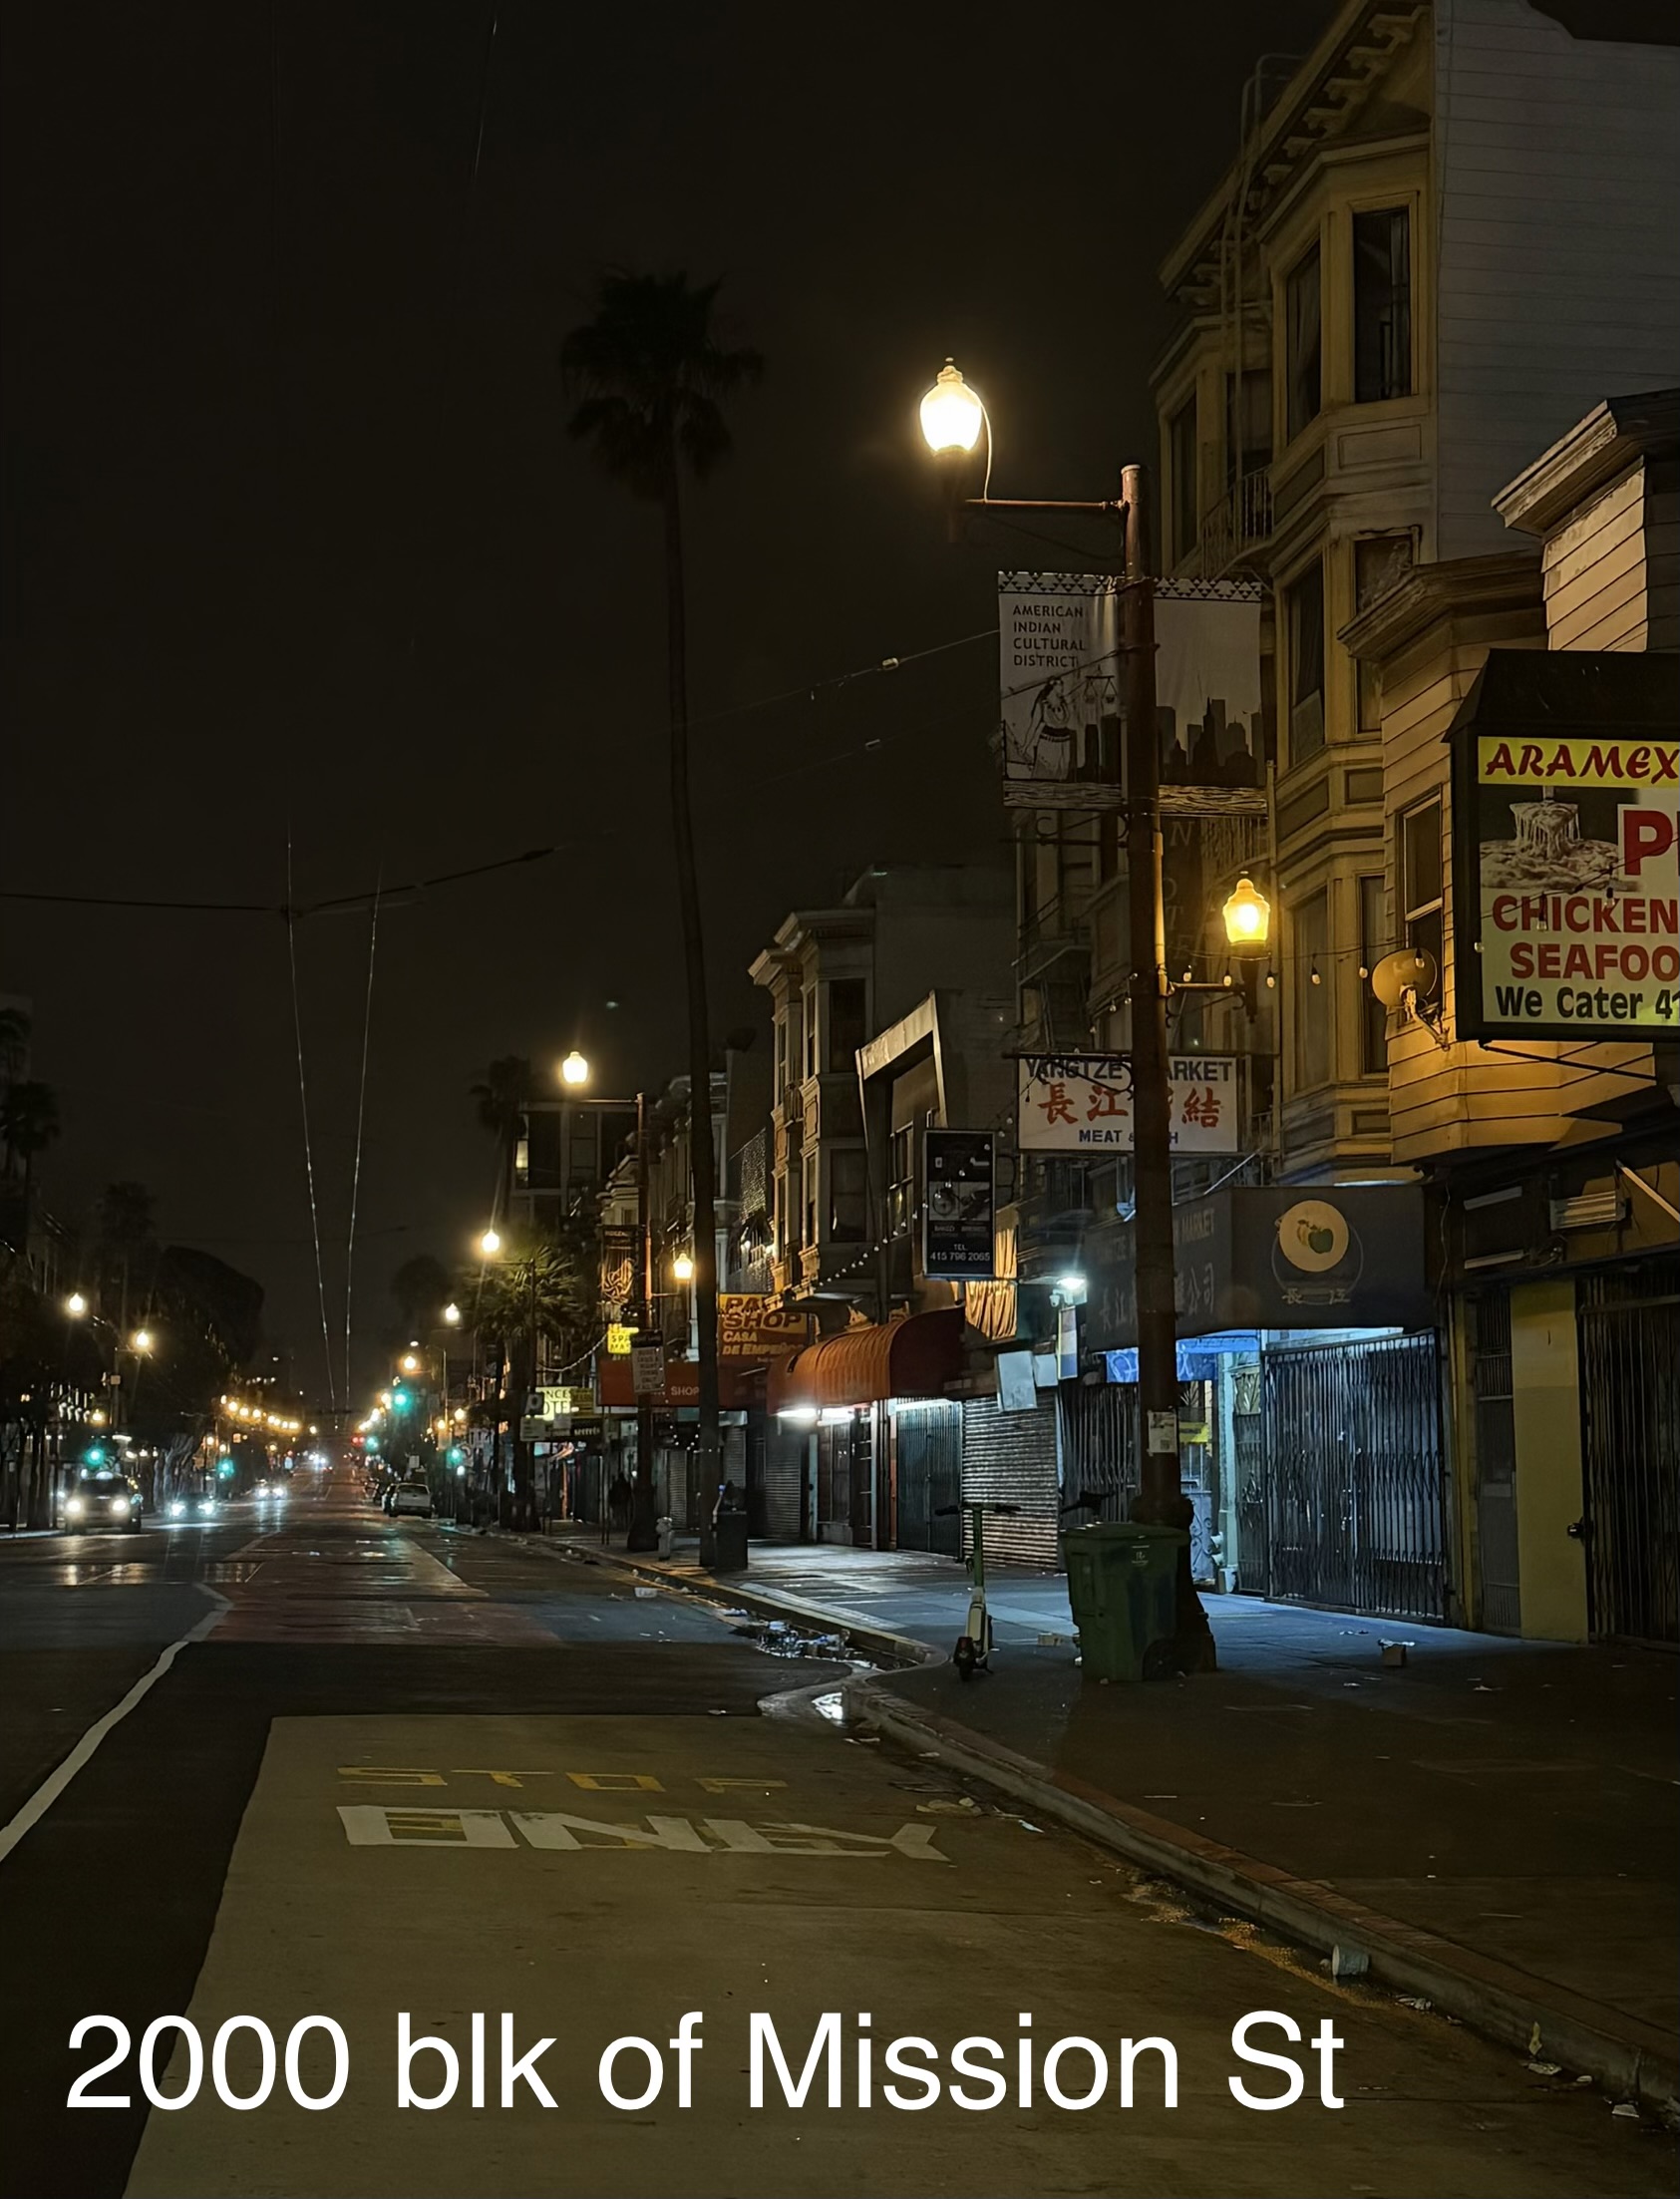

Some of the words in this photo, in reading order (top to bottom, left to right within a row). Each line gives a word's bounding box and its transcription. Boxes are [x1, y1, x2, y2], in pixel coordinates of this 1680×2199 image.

[1012, 604, 1084, 618] AMERICAN
[1013, 621, 1061, 634] INDIAN
[1013, 637, 1085, 651] CULTURAL
[1013, 654, 1079, 668] DISTRICT
[1484, 742, 1680, 785] ARAMEX
[1623, 809, 1680, 878] P
[1492, 895, 1679, 934] CHICKEN
[1510, 941, 1680, 982] SEAFOO
[1496, 986, 1543, 1018] We
[1556, 986, 1643, 1019] Cater
[1025, 1059, 1123, 1079] YANGTZE
[1166, 1060, 1232, 1082] RKET
[1079, 1129, 1123, 1143] MEAT
[723, 1312, 802, 1328] SHOP
[723, 1331, 758, 1343] CASA
[336, 1805, 952, 1861] ONLY
